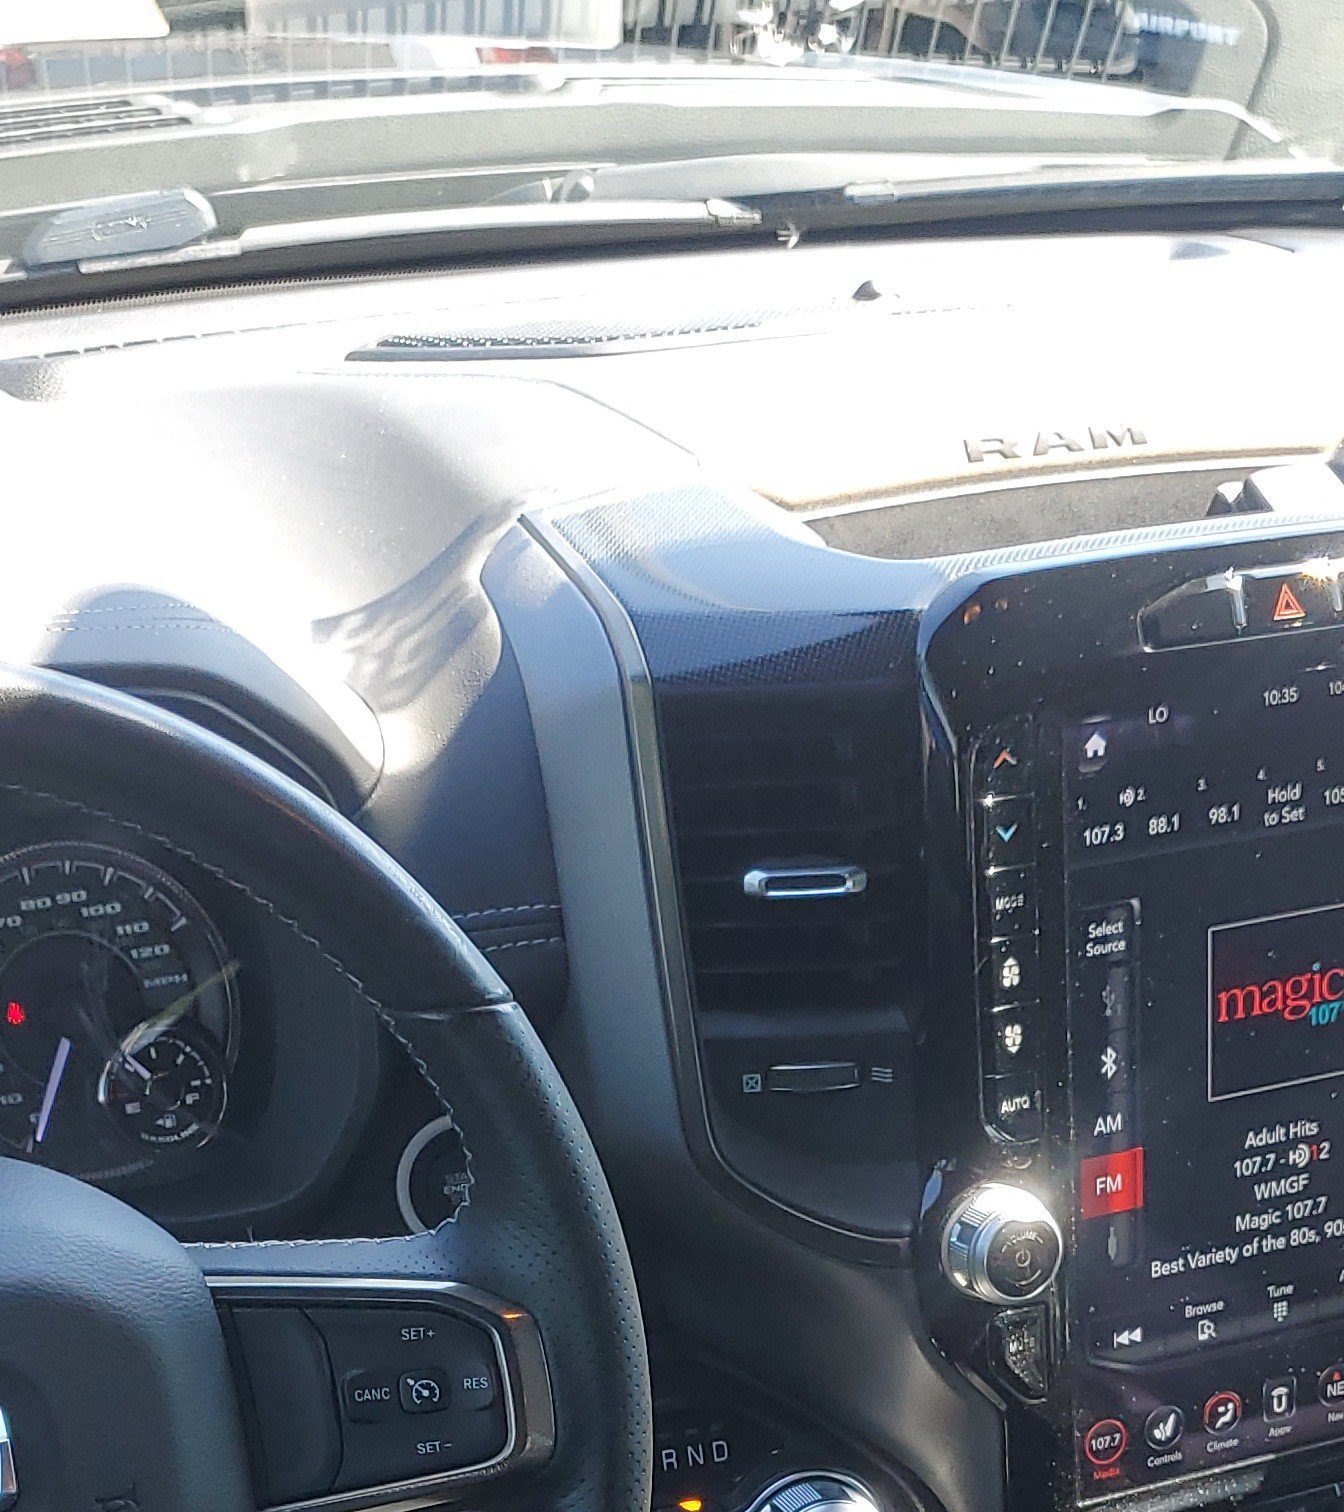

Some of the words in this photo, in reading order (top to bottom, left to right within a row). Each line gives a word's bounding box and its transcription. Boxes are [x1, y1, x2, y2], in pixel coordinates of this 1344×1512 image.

[963, 423, 1148, 463] RAM
[1263, 686, 1299, 707] 10:35
[1148, 706, 1170, 726] LO
[1267, 783, 1303, 805] Hold
[1148, 813, 1180, 835] 88.1
[1208, 804, 1241, 826] 98.1
[1263, 811, 1279, 827] to
[1281, 806, 1306, 824] Set
[1083, 821, 1125, 847] 107.3
[20, 898, 52, 911] 80
[56, 890, 88, 905] 90
[80, 902, 121, 918] 100
[116, 920, 149, 935] 110
[1087, 919, 1124, 939] Select
[131, 944, 171, 959] 120
[1085, 938, 1127, 959] Source
[144, 973, 188, 988] MPH
[0, 1092, 23, 1105] 10
[1001, 1095, 1031, 1114] AUTO
[1093, 1114, 1123, 1137] AM
[1245, 1126, 1287, 1149] Adult
[1289, 1120, 1320, 1140] Hits
[1233, 1154, 1276, 1179] 107.7
[1095, 1174, 1123, 1196] FM
[1254, 1173, 1311, 1201] WMGF
[1236, 1207, 1282, 1233] Magic
[1285, 1196, 1329, 1222] 107.7
[1151, 1258, 1185, 1279] Best
[1186, 1244, 1240, 1274] Variety
[1242, 1238, 1260, 1258] of
[1261, 1233, 1287, 1254] the
[1289, 1226, 1321, 1247] 80s,
[1266, 1282, 1295, 1299] Tune
[1185, 1299, 1225, 1319] Browse
[463, 1377, 489, 1390] RES
[354, 1388, 391, 1402] CANC
[1090, 1432, 1122, 1452] 107.7
[1206, 1437, 1240, 1454] Climate
[662, 1448, 678, 1472] R
[687, 1442, 705, 1467] N
[712, 1440, 729, 1463] D
[1147, 1449, 1184, 1469] Controls
